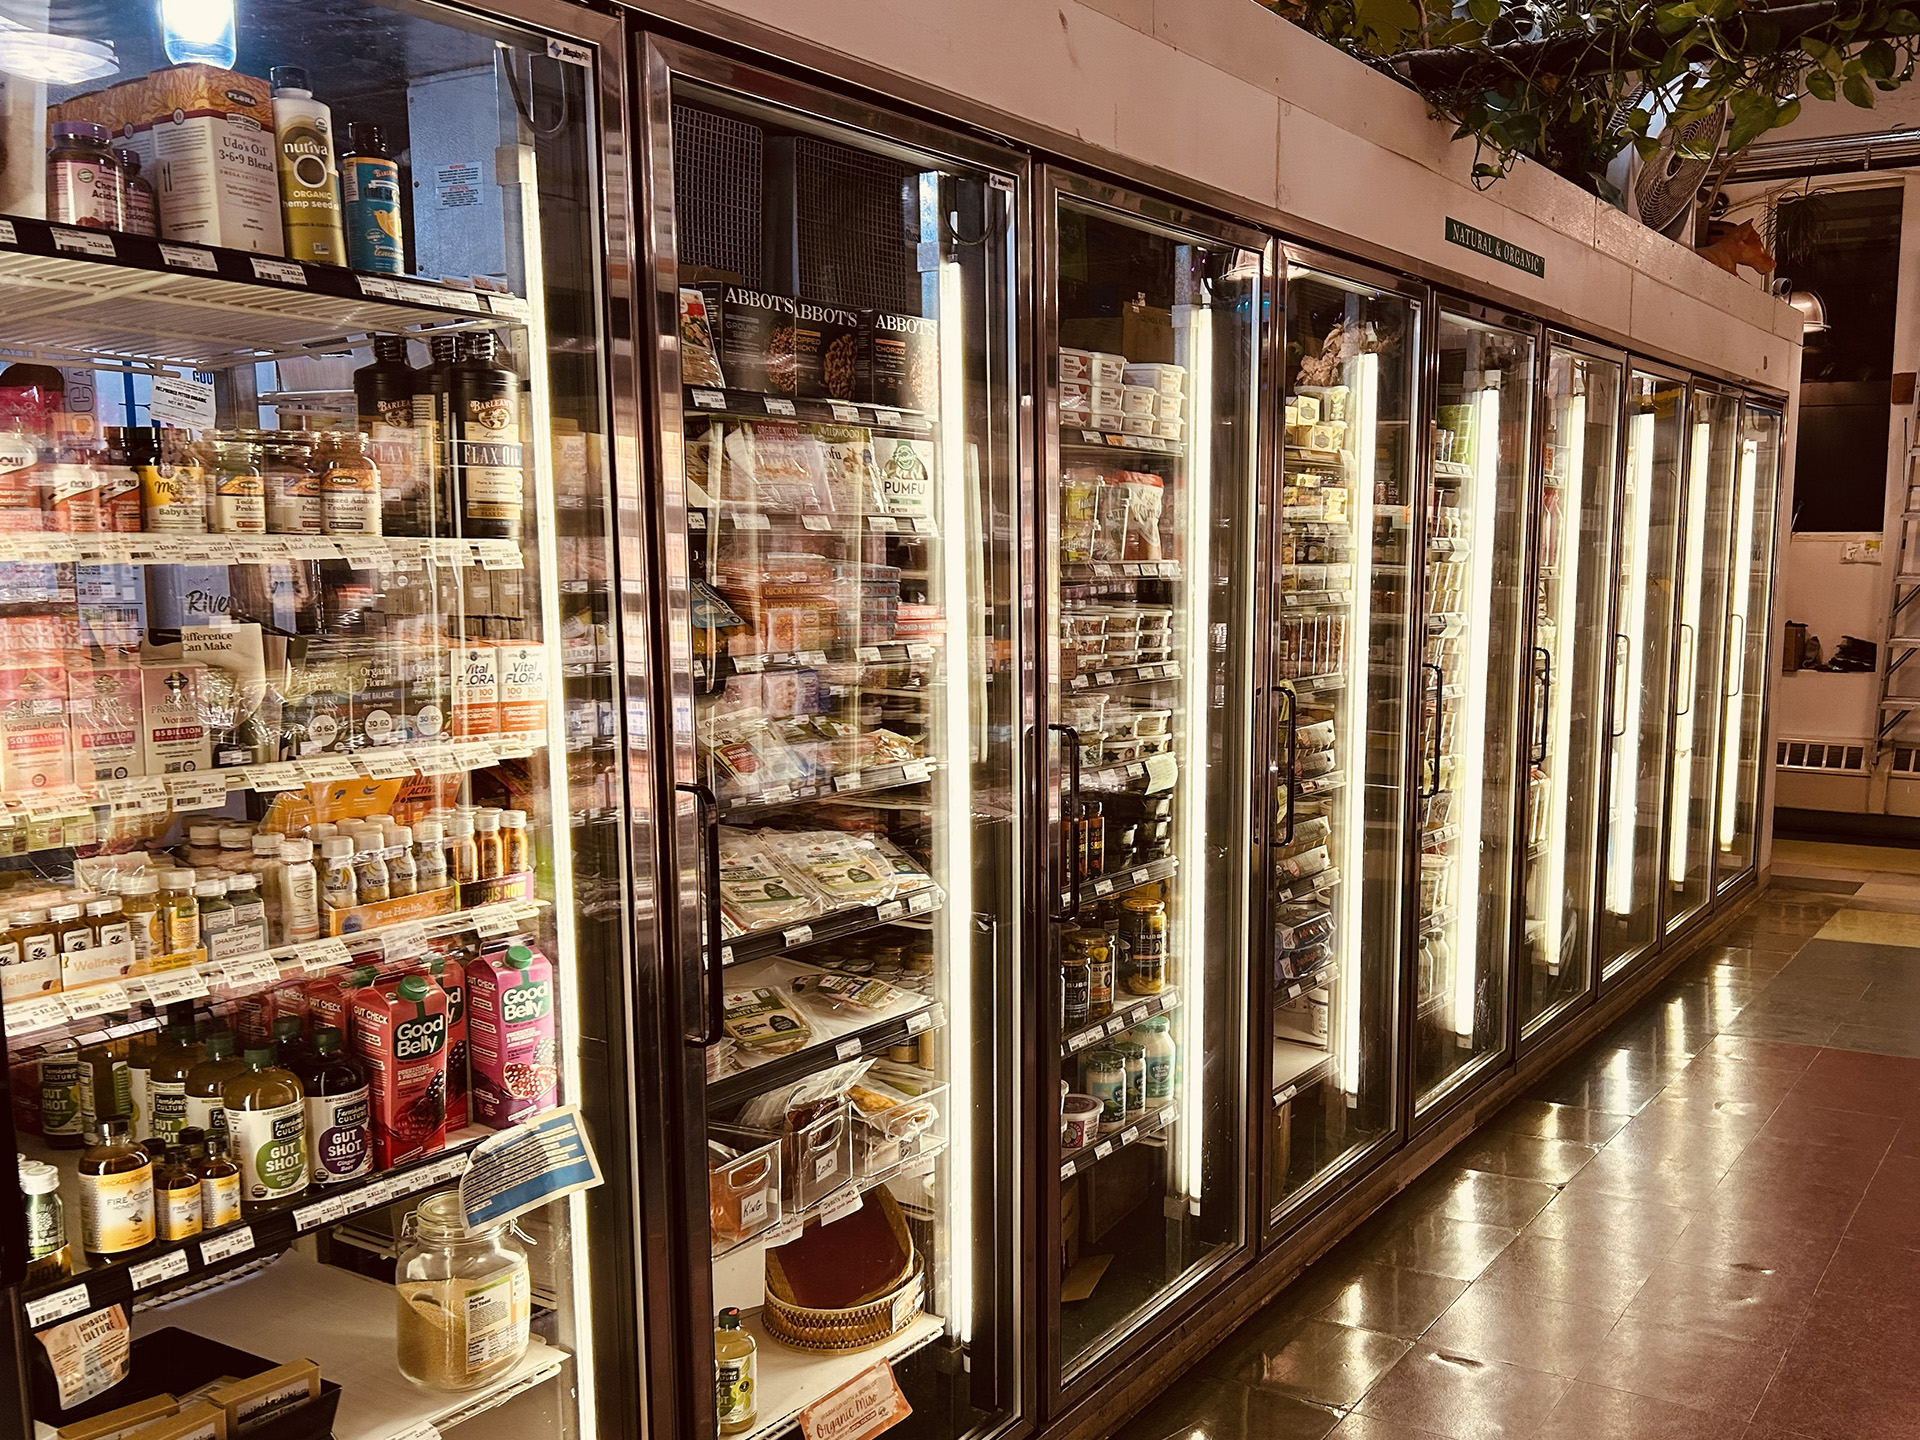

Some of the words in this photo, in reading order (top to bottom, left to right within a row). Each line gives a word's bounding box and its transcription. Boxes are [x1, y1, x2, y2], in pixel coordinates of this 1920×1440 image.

[222, 136, 249, 152] Udo's
[251, 143, 267, 157] Oil
[284, 141, 329, 156] nutiva
[247, 156, 274, 173] Blend
[293, 190, 332, 200] ORGANIC
[282, 200, 309, 210] hemp
[311, 200, 333, 209] seed
[1452, 223, 1493, 254] NATURAL
[1494, 241, 1502, 258] &
[1503, 244, 1540, 272] ORGANIC
[725, 287, 794, 315] ABBOT'S
[725, 321, 760, 333] GROUND
[875, 314, 938, 337] ABBOT'S
[378, 399, 412, 413] BARLEA
[820, 428, 860, 439] WILDWOOD
[463, 444, 499, 466] FLAX
[822, 446, 842, 460] Tofu
[70, 480, 93, 488] now
[117, 479, 137, 488] now
[884, 481, 926, 495] PUMFU
[159, 508, 182, 517] Baby
[327, 504, 364, 512] Probiotic
[764, 587, 799, 596] HICKORY
[771, 602, 805, 610] HICKORY
[182, 643, 202, 652] Can
[203, 642, 232, 652] Make
[360, 666, 396, 677] Organic
[464, 662, 489, 676] Vital
[512, 661, 538, 673] Vital
[364, 679, 387, 687] Flora
[504, 671, 544, 684] FLORA
[361, 692, 372, 700] GUT
[372, 690, 395, 699] BALANCE
[478, 688, 494, 697] 100
[506, 687, 523, 696] 100
[161, 716, 195, 725] Women
[367, 720, 379, 728] 30
[379, 719, 390, 727] 60
[419, 715, 430, 723] 30
[4, 723, 46, 733] Vaginal
[46, 721, 65, 730] Care
[154, 729, 166, 737] 85
[167, 727, 202, 737] BILLION
[503, 882, 527, 897] NOW
[375, 909, 393, 920] Gut
[213, 936, 243, 946] SHARPER
[243, 931, 261, 940] MIND
[215, 949, 236, 958] CALM
[236, 942, 261, 953] ENERGY
[73, 955, 128, 972] Wellness
[503, 980, 549, 1006] Good
[320, 1000, 342, 1013] CHECK
[504, 999, 543, 1021] Belly
[353, 1005, 367, 1017] GUT
[366, 1008, 389, 1026] CHECK
[397, 1014, 445, 1041] Good
[397, 1034, 438, 1058] Belly
[42, 1088, 63, 1099] GUT
[154, 1120, 173, 1131] GUT
[332, 1129, 357, 1144] GUT
[270, 1142, 297, 1160] GUT
[327, 1140, 362, 1157] SHOT
[265, 1153, 301, 1173] SHOT
[336, 1158, 355, 1168] Ginger
[106, 1196, 128, 1206] FIRE
[82, 1320, 116, 1343] CULTURE
[251, 1410, 278, 1426] Gluten
[279, 1404, 297, 1419] Free
[816, 1406, 855, 1439] Organic
[855, 1394, 877, 1412] Miso
